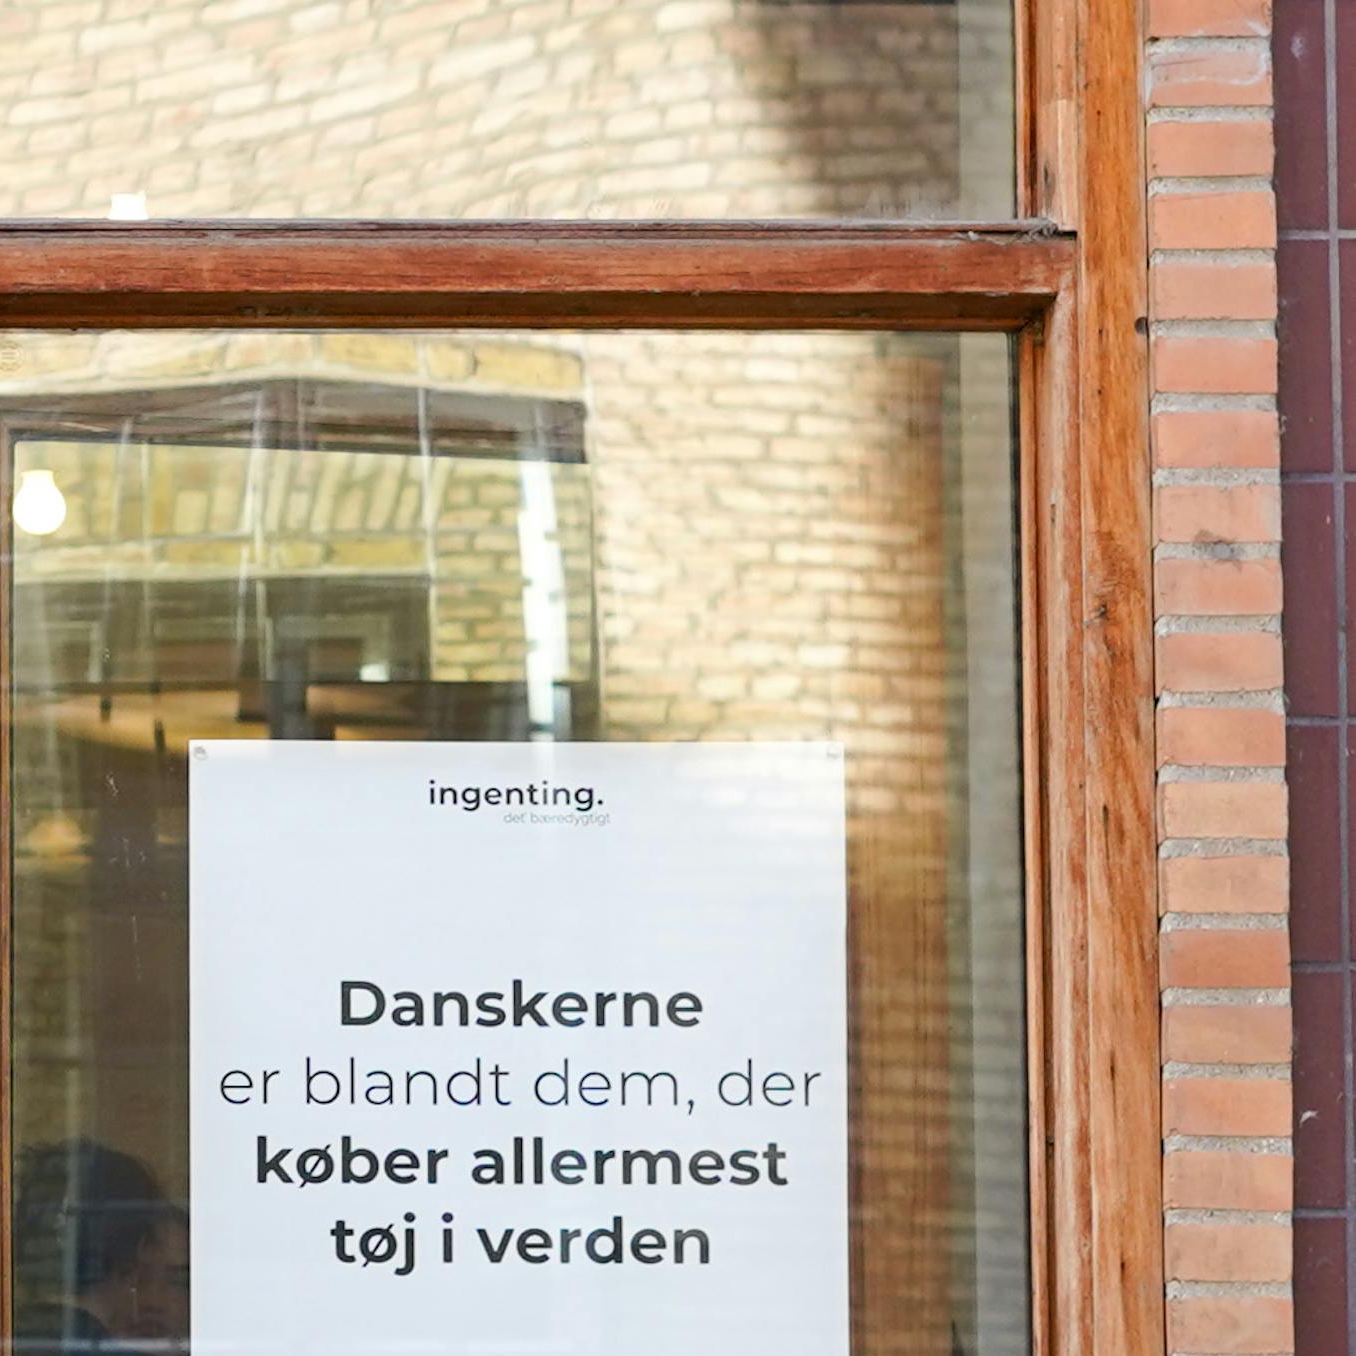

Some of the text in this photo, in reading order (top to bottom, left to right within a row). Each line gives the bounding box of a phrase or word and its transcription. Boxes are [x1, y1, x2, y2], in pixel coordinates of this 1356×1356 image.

[429, 779, 604, 812] ingenting.
[340, 978, 703, 1028] Danskerne
[219, 1056, 822, 1116] er blandt dem, der
[257, 1135, 789, 1188] køber allermest
[330, 1211, 710, 1276] tøj i verden
